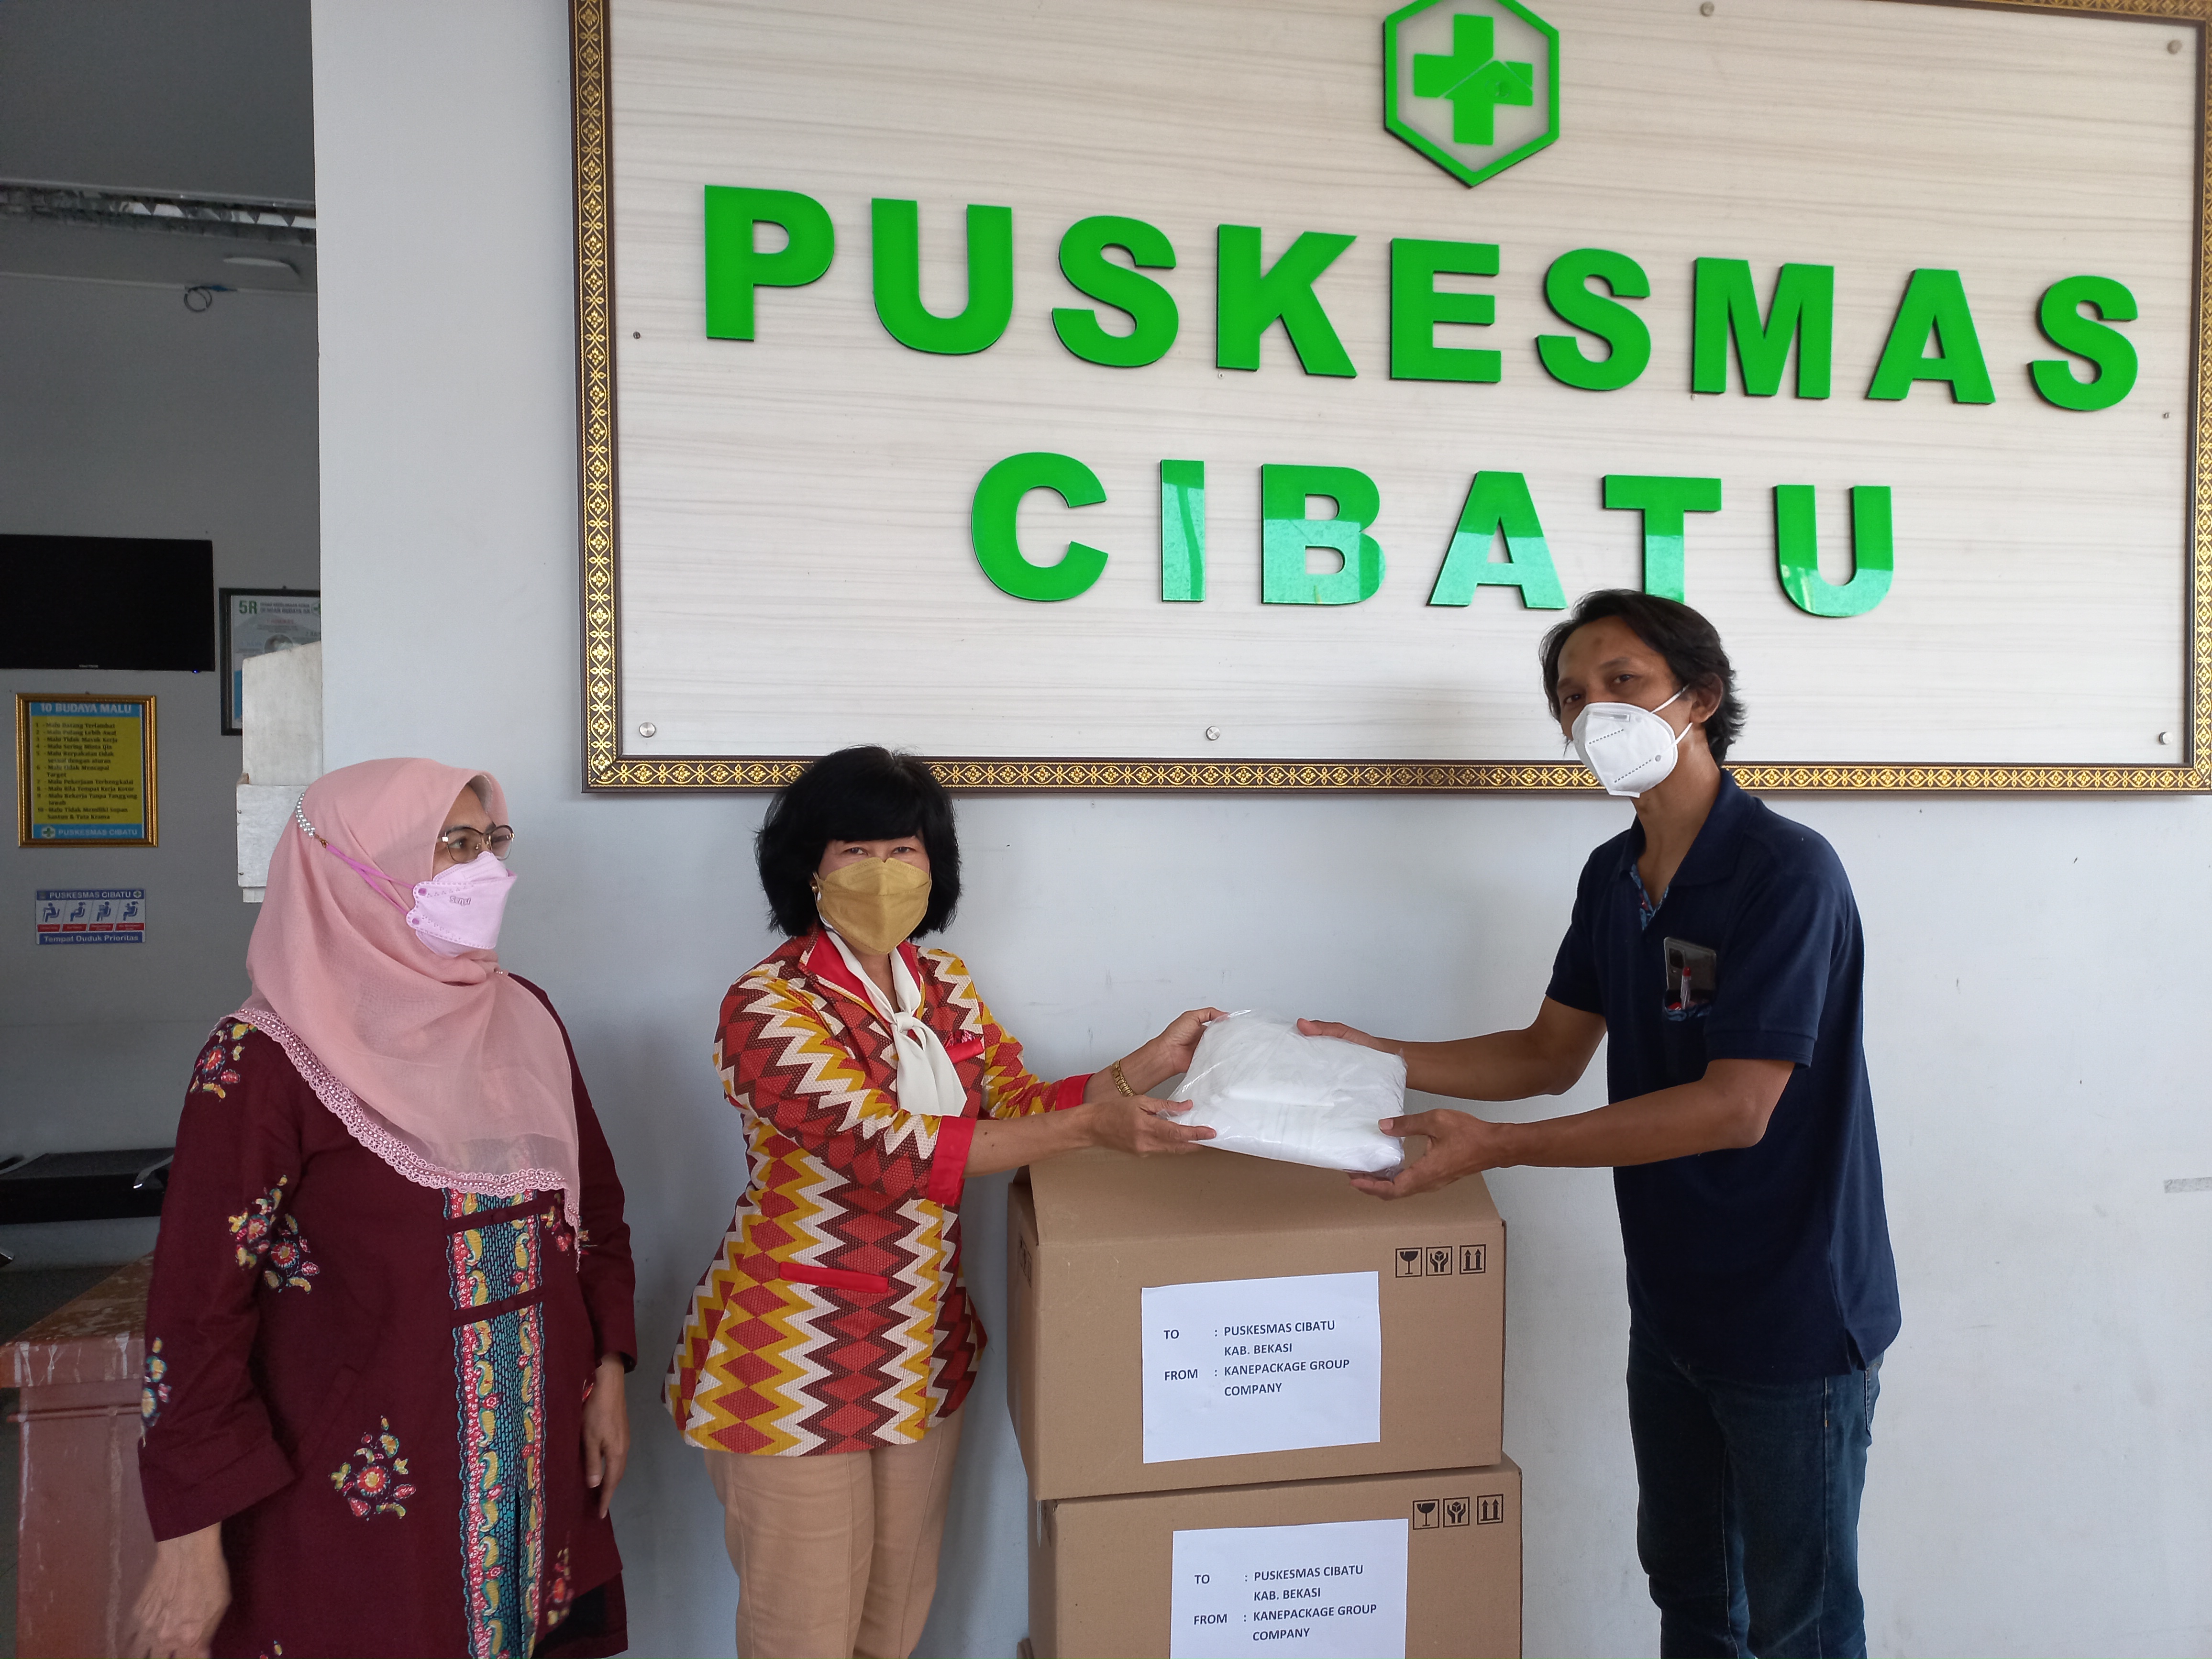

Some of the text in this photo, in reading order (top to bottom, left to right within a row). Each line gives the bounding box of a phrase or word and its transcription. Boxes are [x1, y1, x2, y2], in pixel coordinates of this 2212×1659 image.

[702, 184, 2140, 412] PUSKESMAS
[970, 451, 1895, 618] CIBATU
[239, 600, 257, 614] 5R
[41, 703, 131, 713] 10 BUDAYA MALU
[1164, 1330, 1179, 1339] TO
[1225, 1323, 1291, 1336] PUSKESMAS
[1295, 1320, 1334, 1332] CIBATU
[1225, 1343, 1292, 1356] KAB. BEKASI
[1165, 1369, 1197, 1380] FROM
[1225, 1362, 1305, 1375] KANEPACKAGE
[1310, 1360, 1349, 1370] GROUP
[1225, 1383, 1282, 1396] COMPANY
[1194, 1575, 1209, 1584] TO
[1255, 1568, 1320, 1581] PUSKESMAS
[1324, 1565, 1362, 1576] CIBATU
[1254, 1588, 1320, 1601] KAB. BEKASI
[1194, 1614, 1227, 1625] FROM
[1254, 1607, 1334, 1621] KANEPACKAGE
[1338, 1604, 1376, 1615] GROUP
[1253, 1628, 1309, 1640] COMPANY
